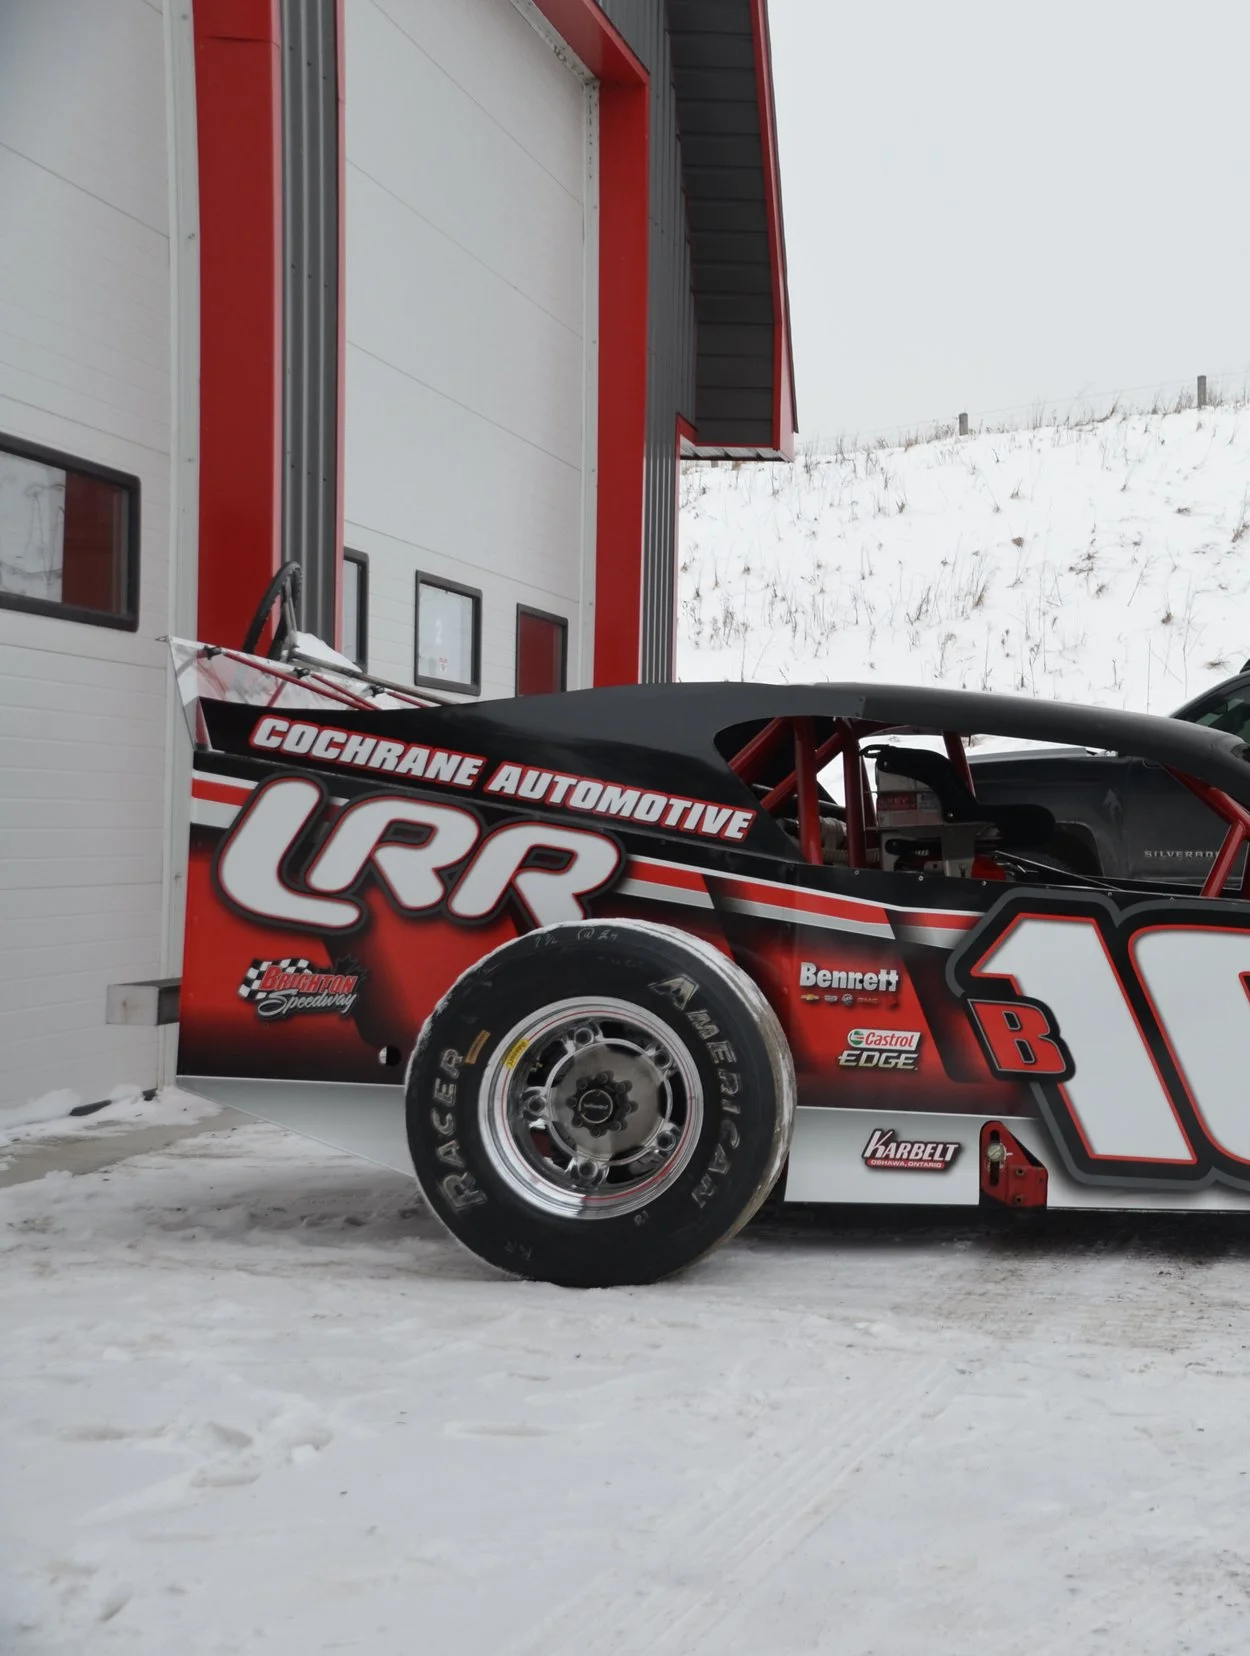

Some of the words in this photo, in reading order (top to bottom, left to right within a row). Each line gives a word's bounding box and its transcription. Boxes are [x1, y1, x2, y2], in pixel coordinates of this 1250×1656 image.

[252, 716, 486, 787] COCHRANE
[486, 763, 754, 840] AUTOMOTIVE
[218, 778, 620, 928] LRR
[260, 965, 358, 995] BRIGHTON
[799, 961, 899, 992] Bennett
[257, 988, 358, 1017] Speedway
[865, 1031, 915, 1049] Castrol
[967, 998, 1068, 1076] B
[838, 1049, 919, 1071] EDGE
[647, 972, 742, 1210] AMERICAN
[430, 1047, 488, 1213] RACER
[863, 1129, 960, 1162] KARBELT
[907, 1161, 943, 1169] ONTARIO
